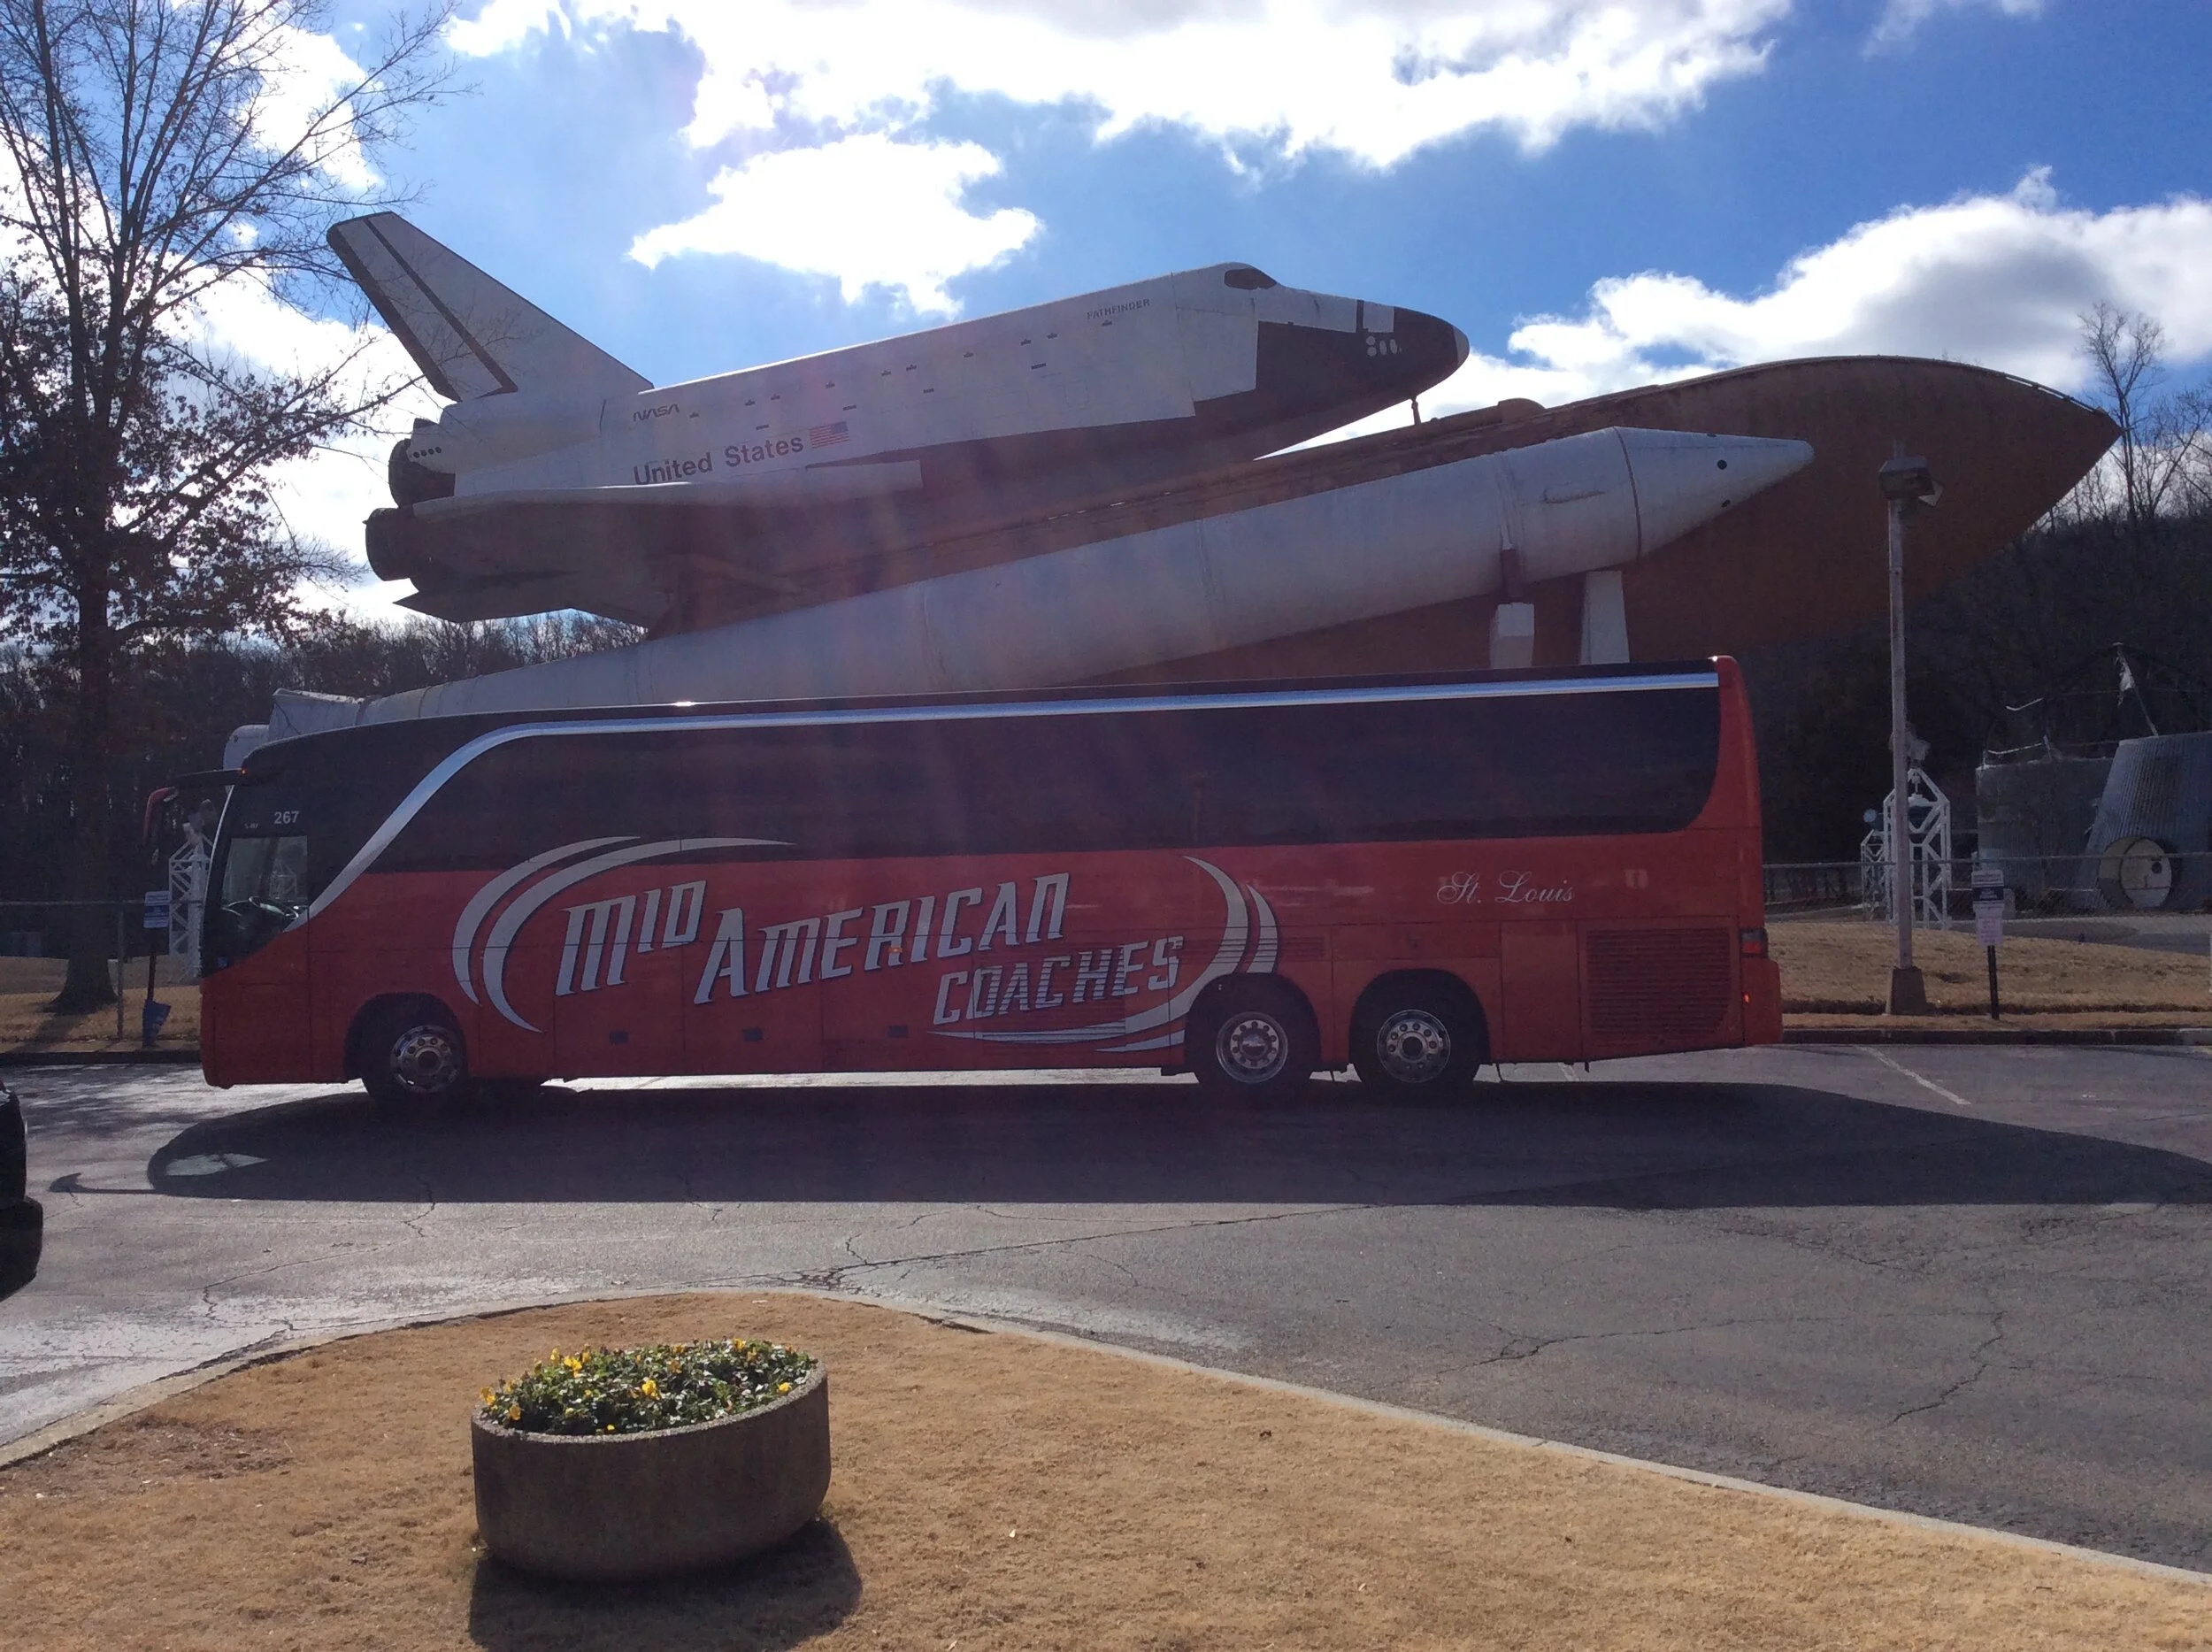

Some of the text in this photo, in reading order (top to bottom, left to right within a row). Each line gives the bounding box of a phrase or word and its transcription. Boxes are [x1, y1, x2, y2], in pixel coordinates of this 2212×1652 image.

[1087, 298, 1151, 319] PATHFINDER
[633, 403, 680, 422] NASA
[634, 435, 804, 486] United States
[273, 810, 300, 825] 267
[1436, 870, 1574, 905] St. Louis
[693, 872, 1071, 1004] AMERICAN
[932, 934, 1185, 1027] COACHES
